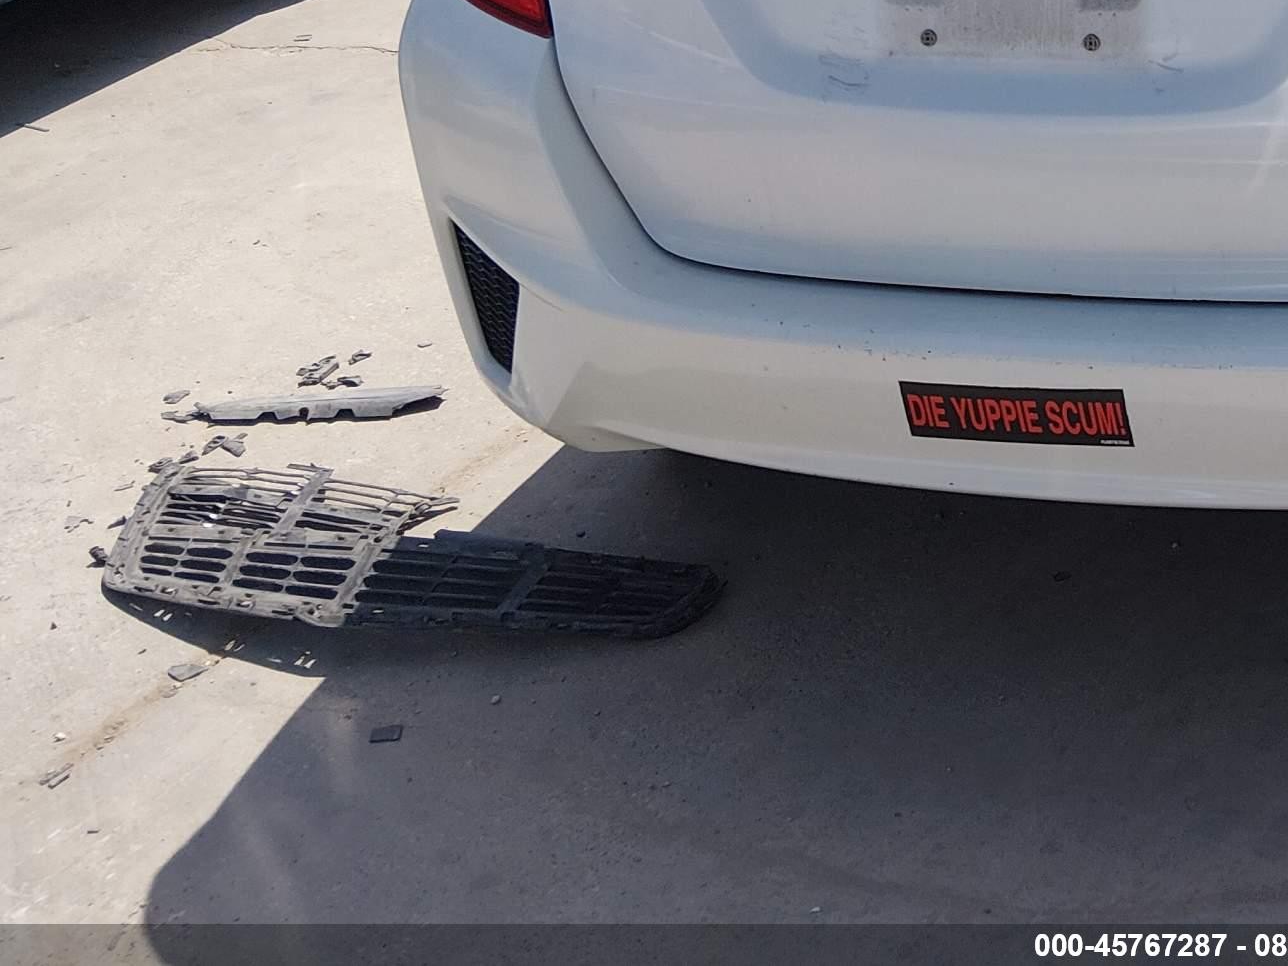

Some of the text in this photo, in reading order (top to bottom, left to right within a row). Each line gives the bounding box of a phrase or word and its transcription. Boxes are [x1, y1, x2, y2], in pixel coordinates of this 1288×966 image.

[907, 393, 1127, 436] DIE YUPPIE SCUM!
